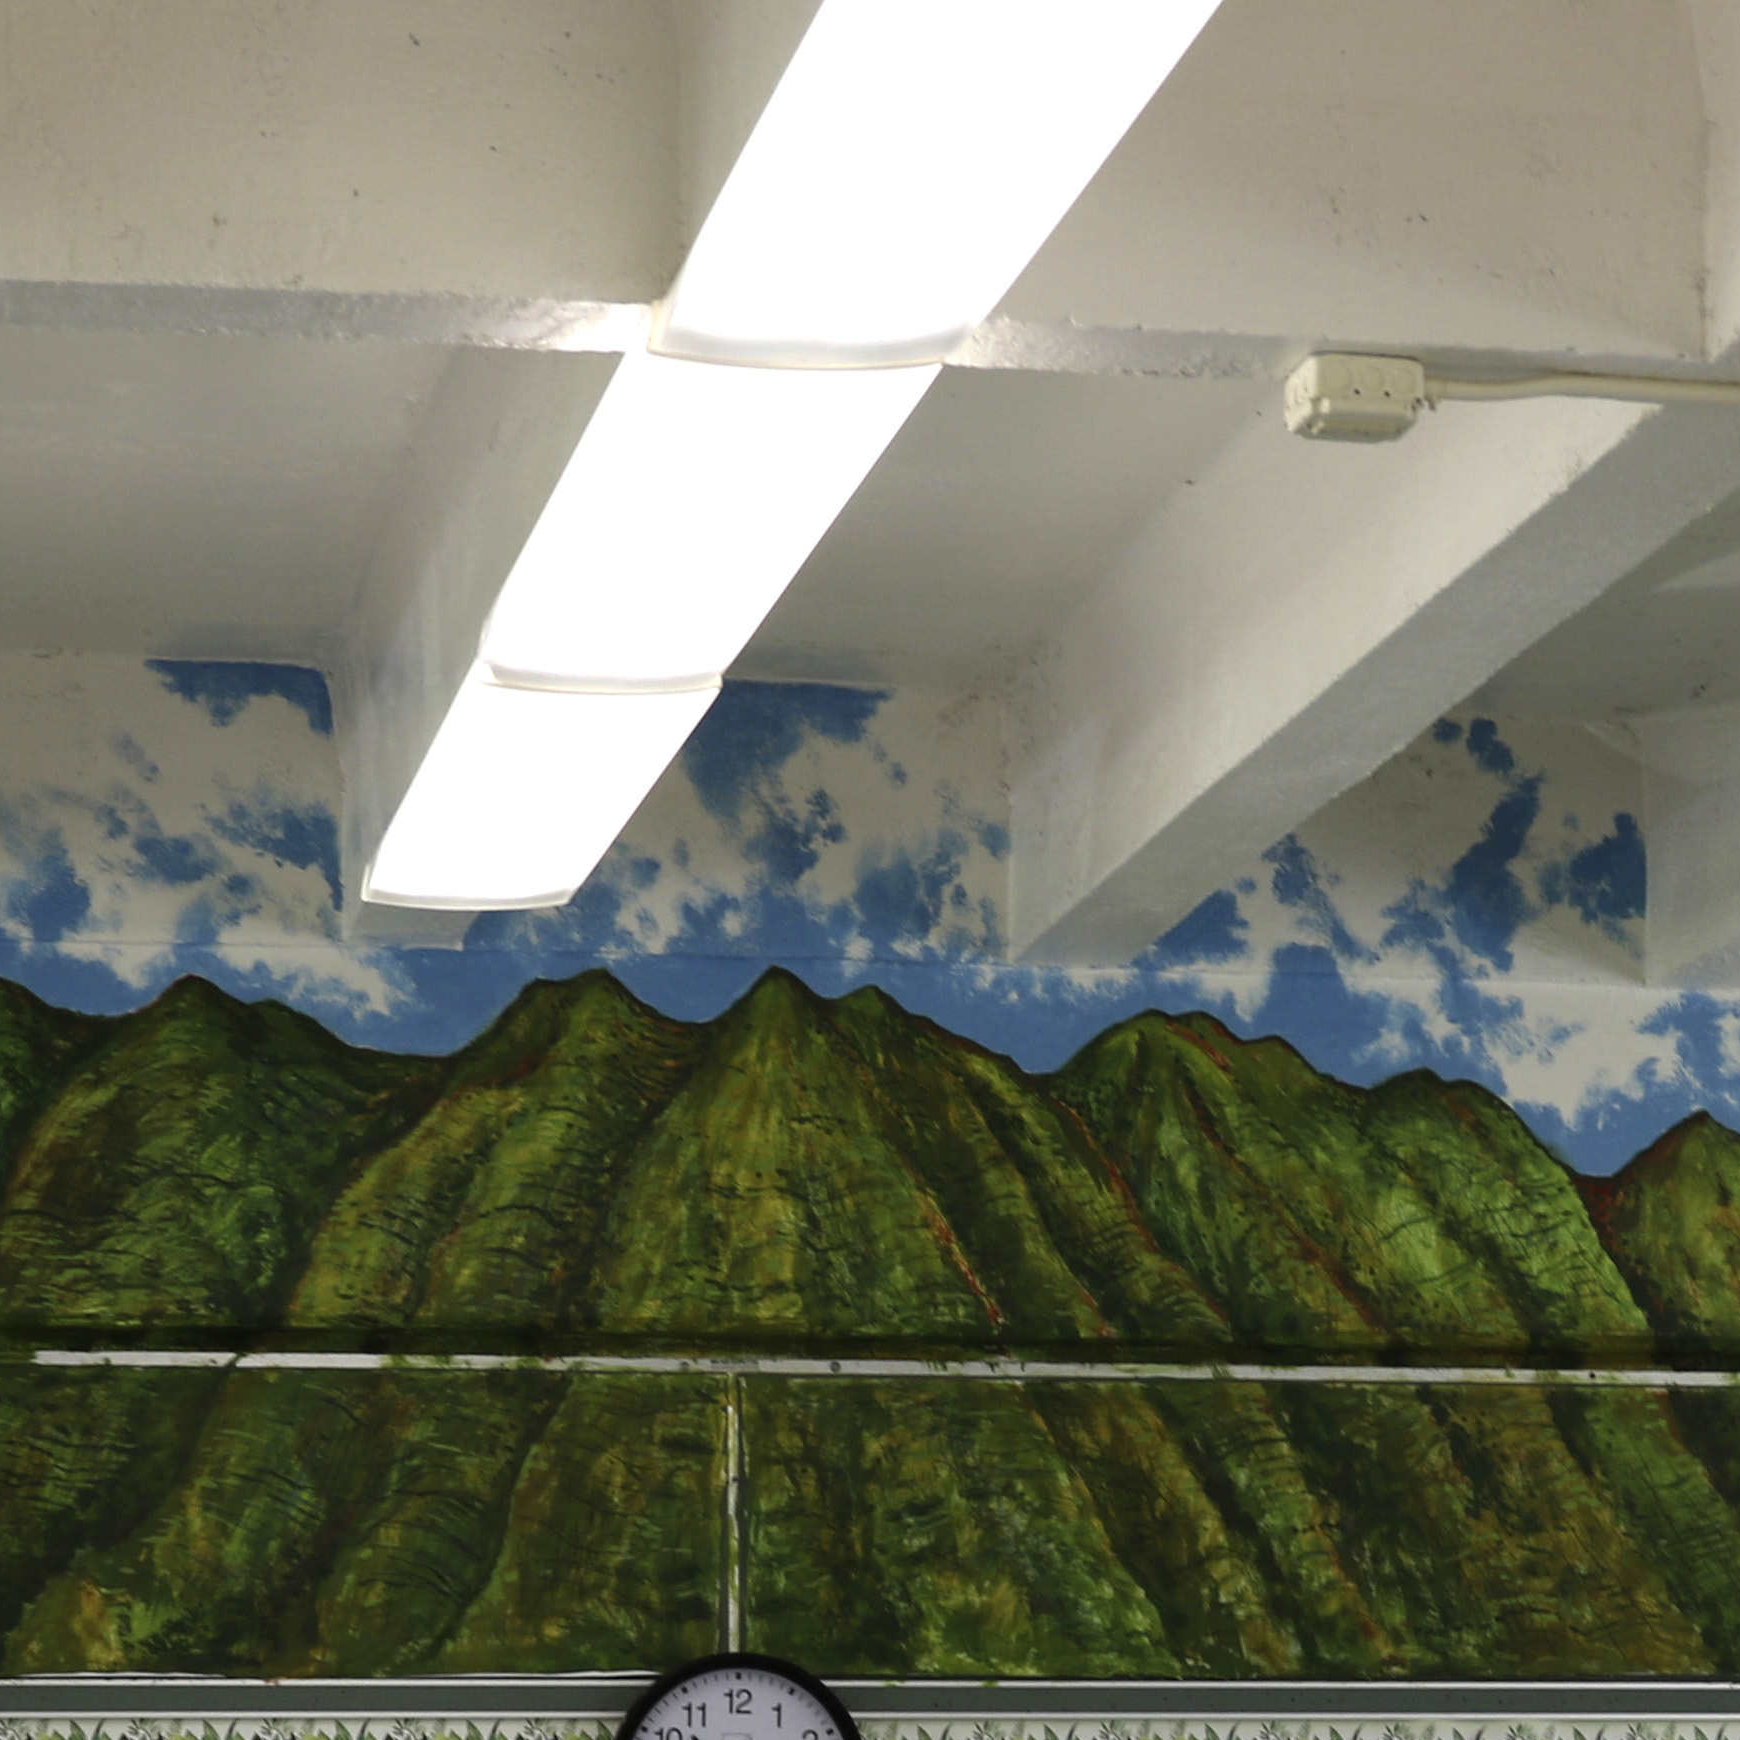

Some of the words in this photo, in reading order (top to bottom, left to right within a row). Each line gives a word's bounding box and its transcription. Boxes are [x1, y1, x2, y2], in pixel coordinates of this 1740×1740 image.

[724, 1689, 752, 1715] 12
[682, 1703, 708, 1728] 11
[772, 1703, 784, 1728] 1
